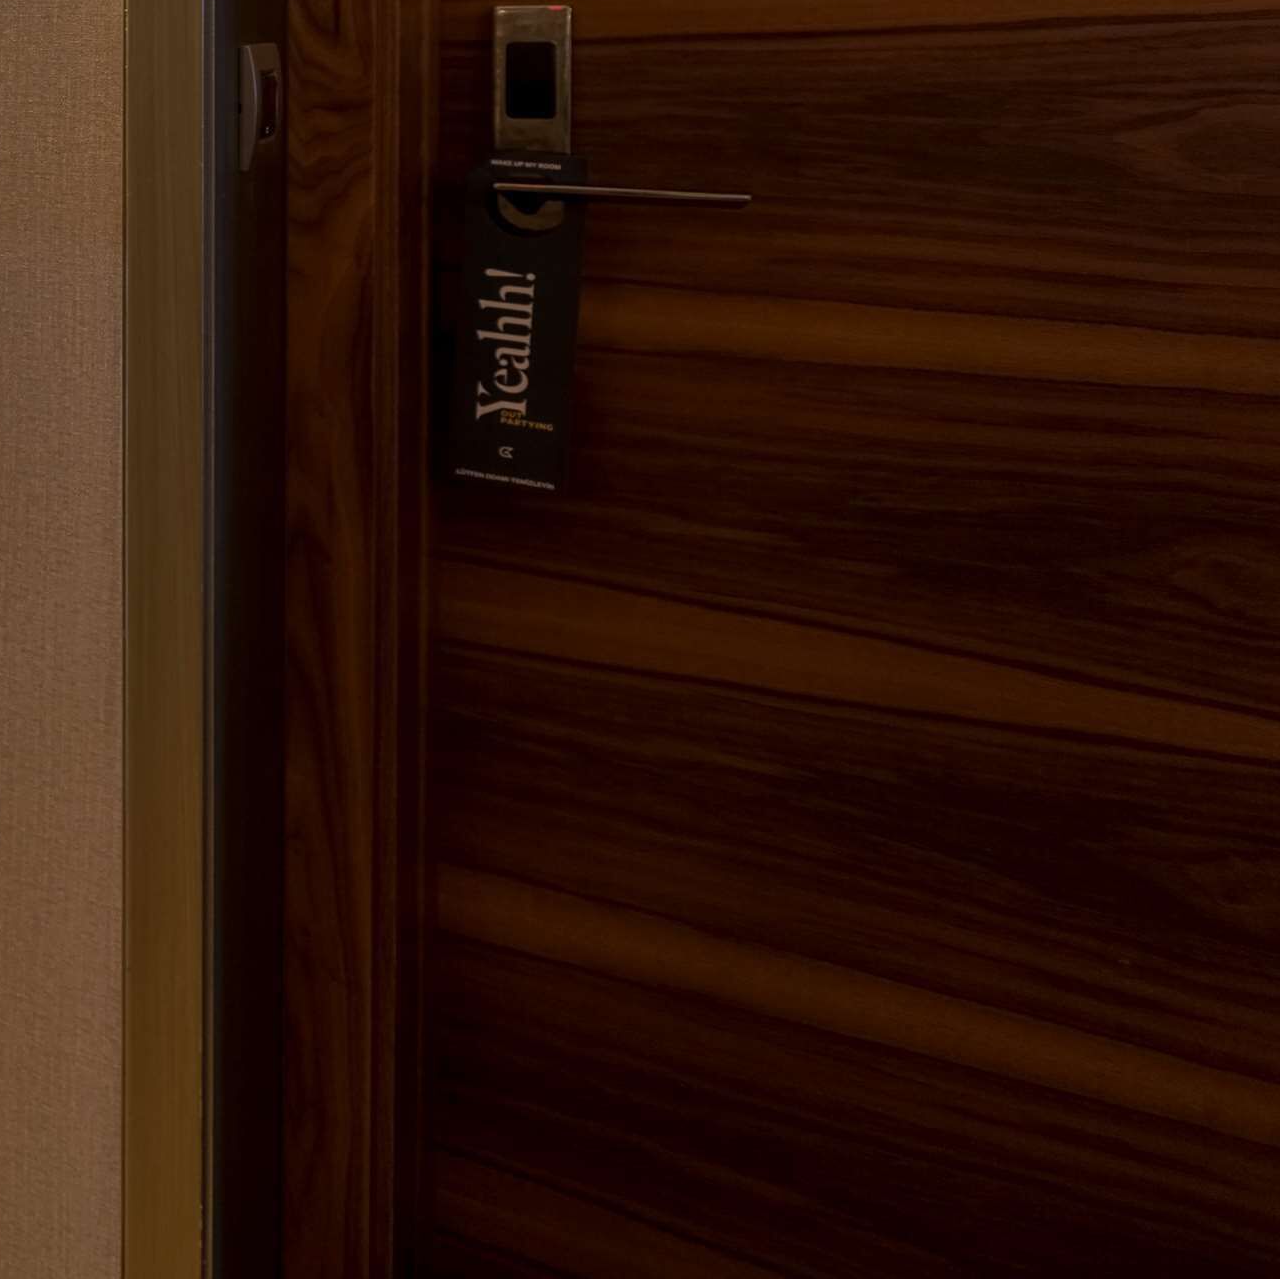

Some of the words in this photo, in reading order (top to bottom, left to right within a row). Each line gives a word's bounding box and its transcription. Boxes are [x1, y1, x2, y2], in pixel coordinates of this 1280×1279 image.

[537, 163, 562, 171] ROOM
[475, 267, 536, 420] Yeahh!
[499, 410, 522, 418] OUT
[499, 417, 554, 431] PARTYING
